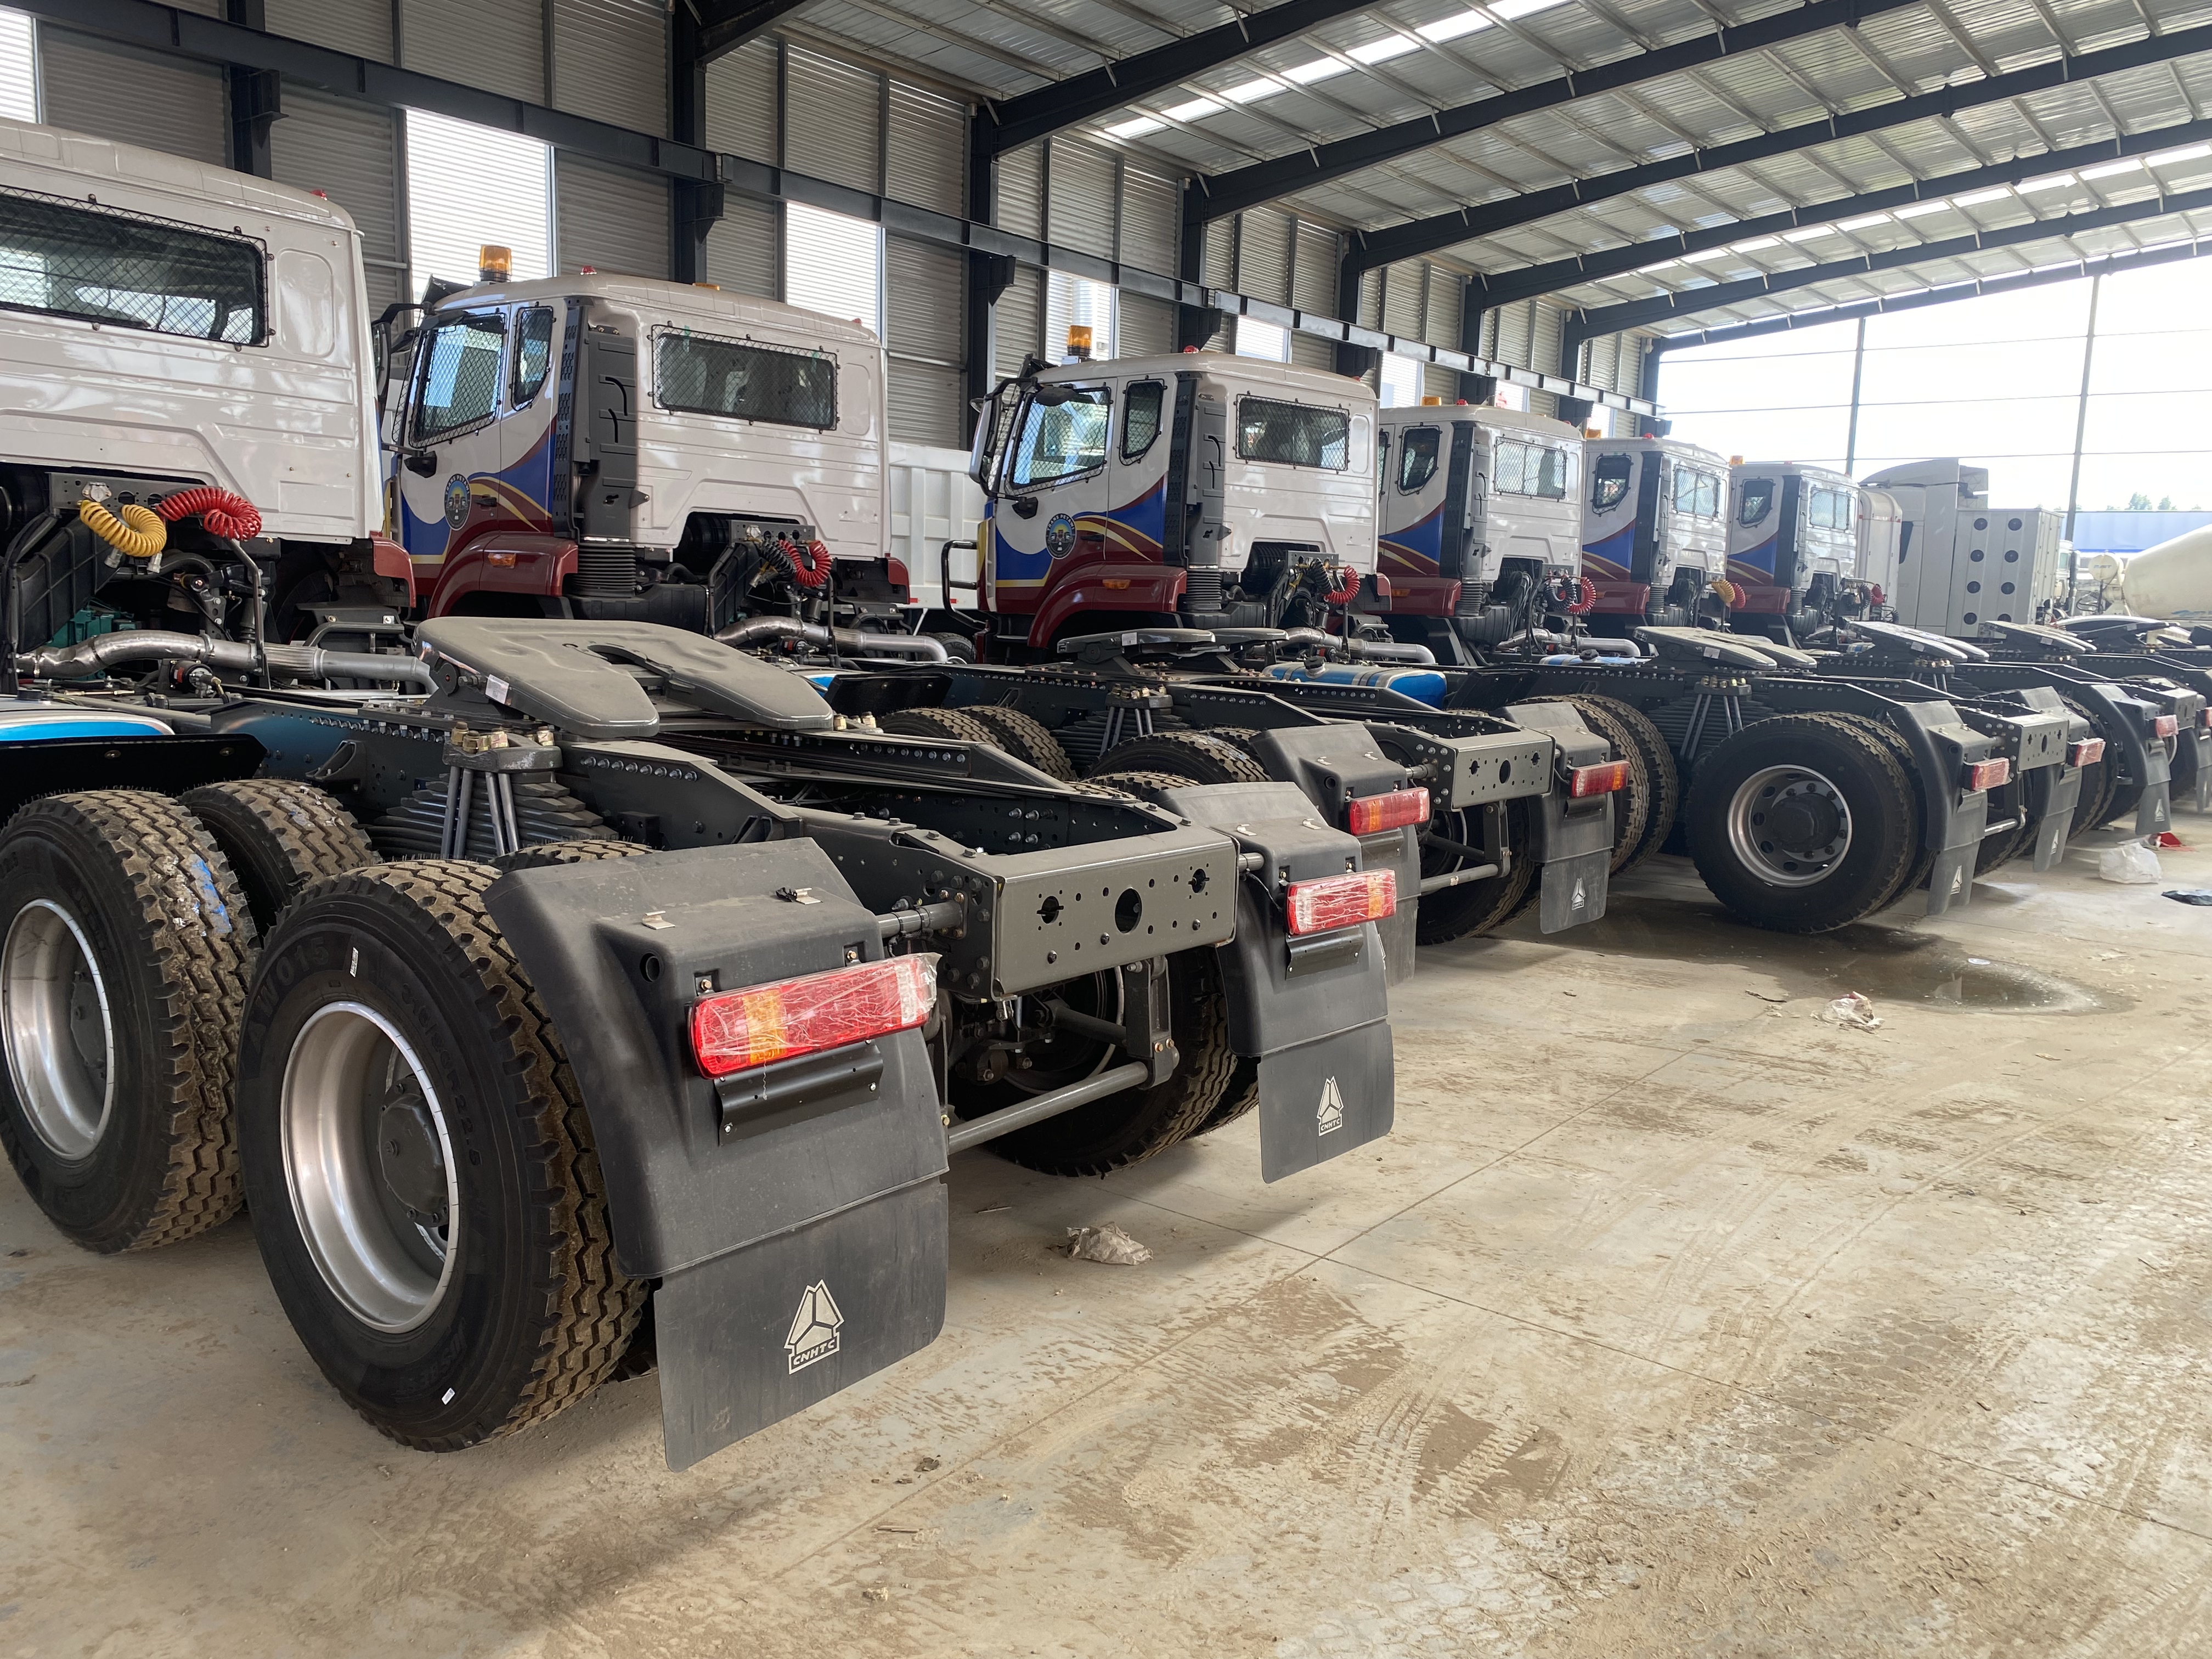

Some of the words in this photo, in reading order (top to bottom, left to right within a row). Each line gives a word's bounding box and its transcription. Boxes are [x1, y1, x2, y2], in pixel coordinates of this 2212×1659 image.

[445, 476, 456, 494] TRANS
[1047, 515, 1059, 531] TRANS
[1060, 514, 1075, 530] PETAWI
[1321, 1118, 1340, 1131] CNHTC
[793, 1339, 835, 1365] CNHTC
